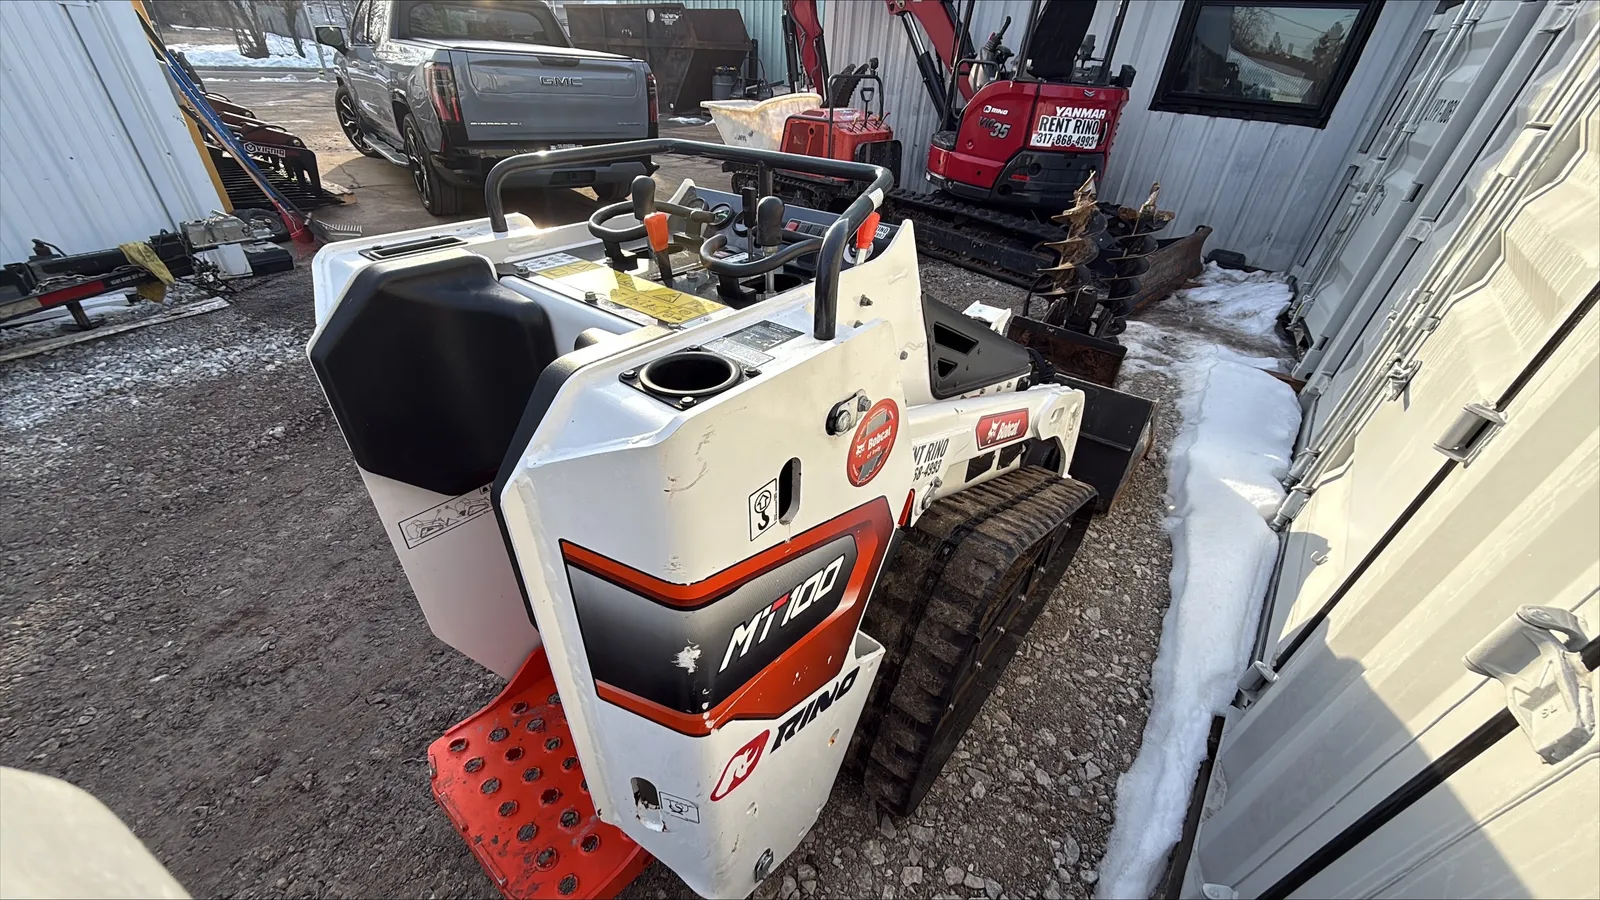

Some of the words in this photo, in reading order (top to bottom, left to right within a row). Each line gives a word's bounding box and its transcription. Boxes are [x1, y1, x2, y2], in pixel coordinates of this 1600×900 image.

[540, 75, 584, 86] GMC
[991, 107, 1009, 115] RINO
[1055, 106, 1107, 119] YANMAR
[1039, 116, 1072, 133] RENT
[1073, 119, 1100, 135] RINO
[1036, 132, 1095, 147] 317-868-4993
[867, 425, 892, 451] Bobcat
[996, 419, 1021, 441] Bobcat
[925, 438, 949, 462] RINO
[718, 555, 845, 673] MT100
[769, 666, 861, 755] RINO
